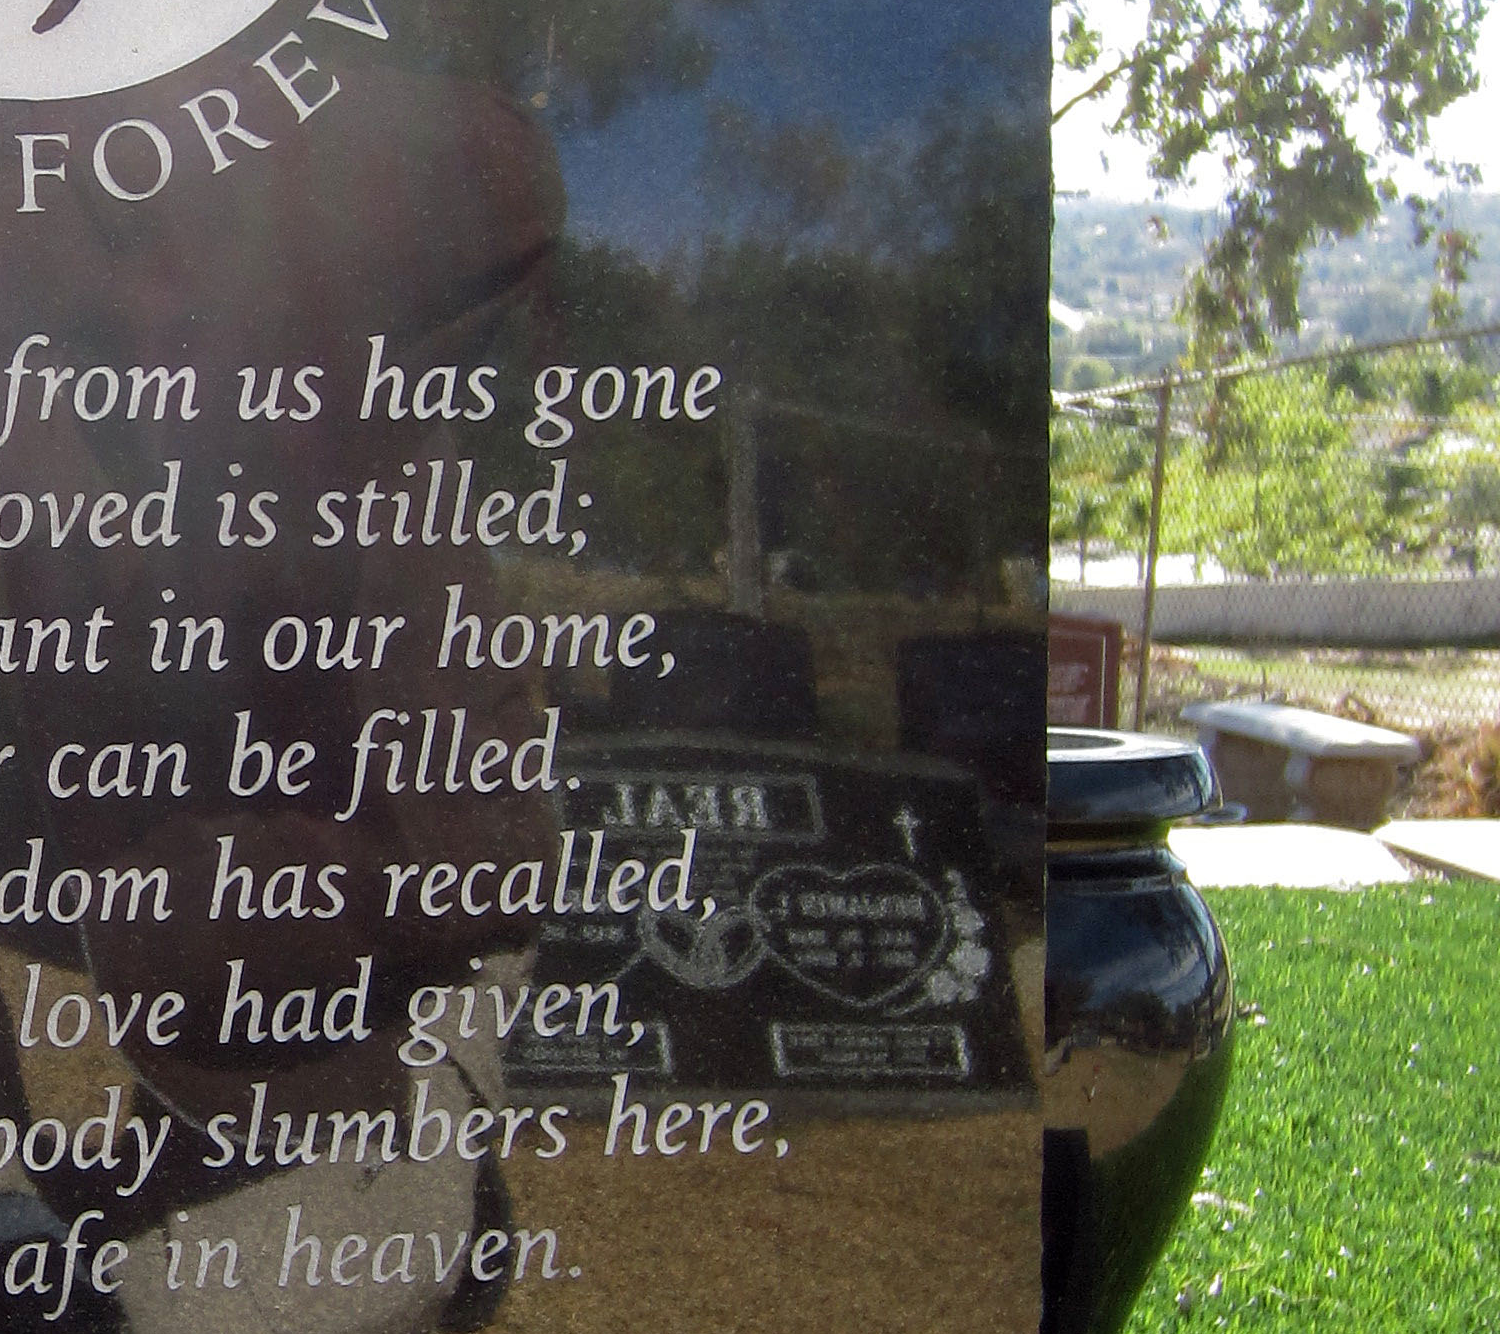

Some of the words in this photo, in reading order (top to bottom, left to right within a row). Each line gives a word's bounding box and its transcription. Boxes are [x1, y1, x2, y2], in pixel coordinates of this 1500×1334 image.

[238, 366, 323, 420] us
[360, 335, 497, 420] has
[525, 366, 721, 447] gone
[217, 464, 278, 547] is
[313, 459, 591, 555] stilled;
[150, 590, 228, 671] in
[264, 617, 405, 670] our
[438, 585, 674, 677] home,
[48, 743, 190, 798] can
[229, 711, 315, 796] be
[335, 708, 580, 821] filled.
[209, 836, 346, 919] has
[383, 830, 716, 920] recalled,
[20, 964, 185, 1047] love
[219, 956, 372, 1043] had
[398, 958, 644, 1066] given,
[203, 1079, 568, 1167] slumbers
[605, 1074, 788, 1157] here,
[168, 1212, 237, 1289] in
[279, 1207, 581, 1286] heaven.
